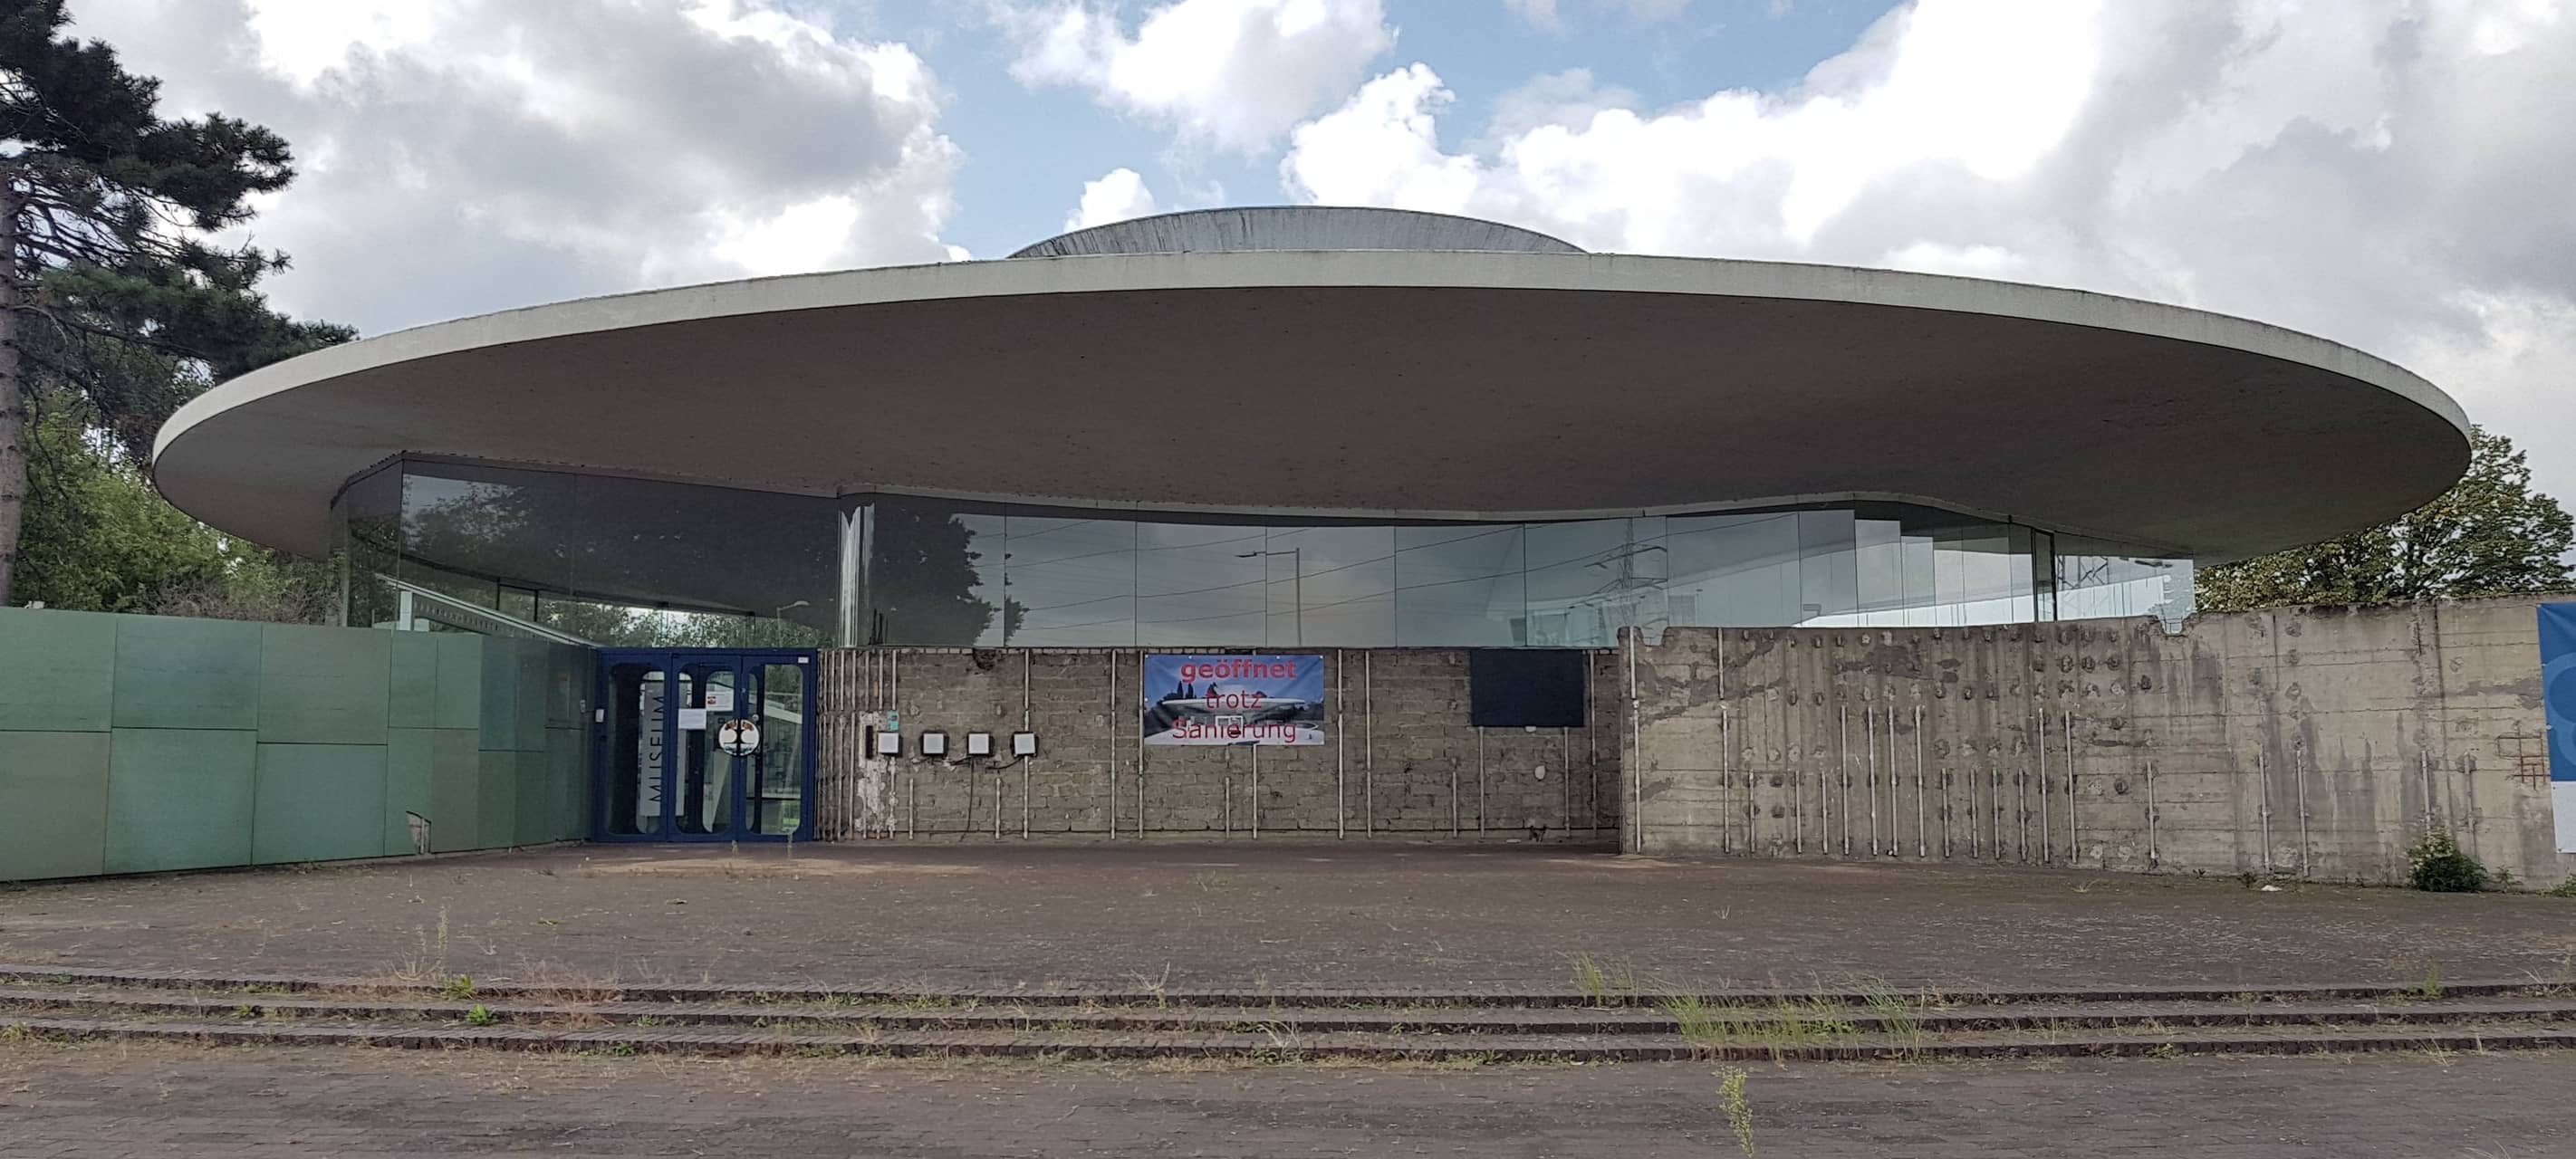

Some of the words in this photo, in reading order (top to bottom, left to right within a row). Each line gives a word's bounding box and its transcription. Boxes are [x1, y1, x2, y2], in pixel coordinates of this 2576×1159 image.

[1181, 658, 1296, 683] geöffnet
[1206, 690, 1262, 709] trotz
[1172, 718, 1296, 743] Sanierung
[649, 695, 665, 803] MUSEUM
